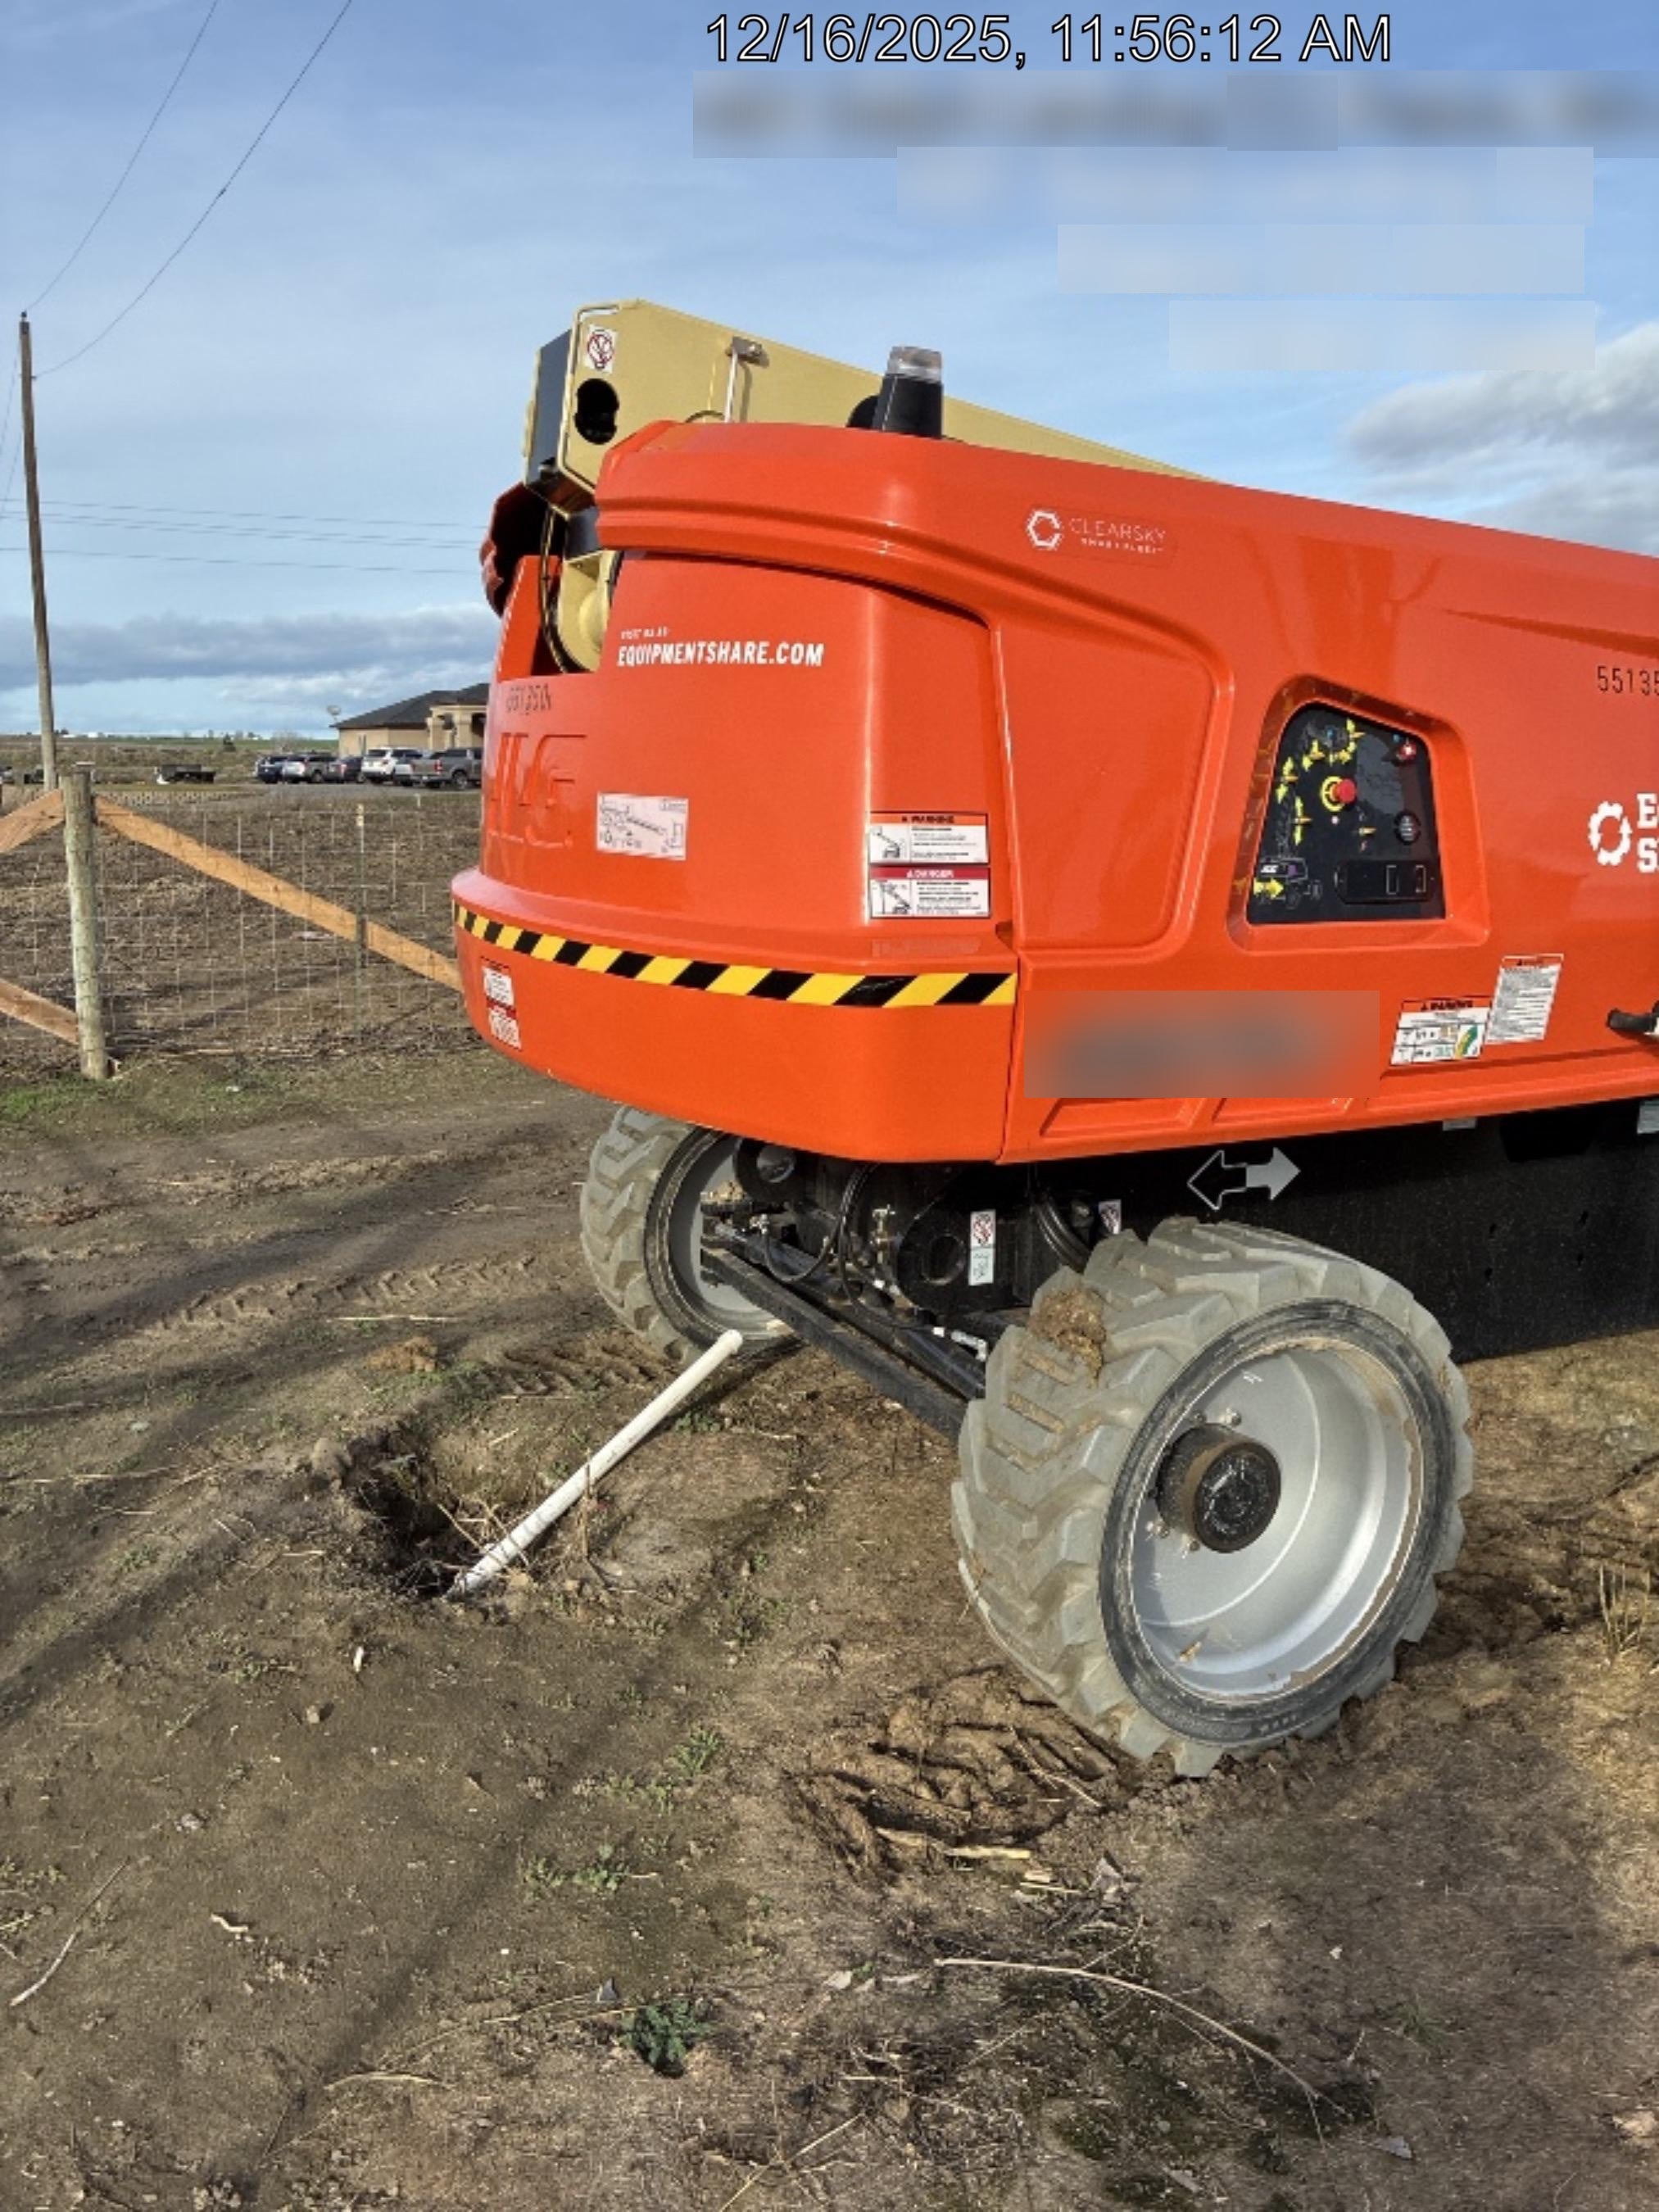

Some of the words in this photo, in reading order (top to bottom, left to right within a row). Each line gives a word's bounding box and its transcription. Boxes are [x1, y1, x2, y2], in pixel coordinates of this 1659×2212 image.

[1069, 517, 1167, 544] CLEARSKY
[617, 641, 825, 667] EQUIPMENTSHARE.COM
[1637, 792, 1659, 829] E
[1637, 836, 1659, 873] S
